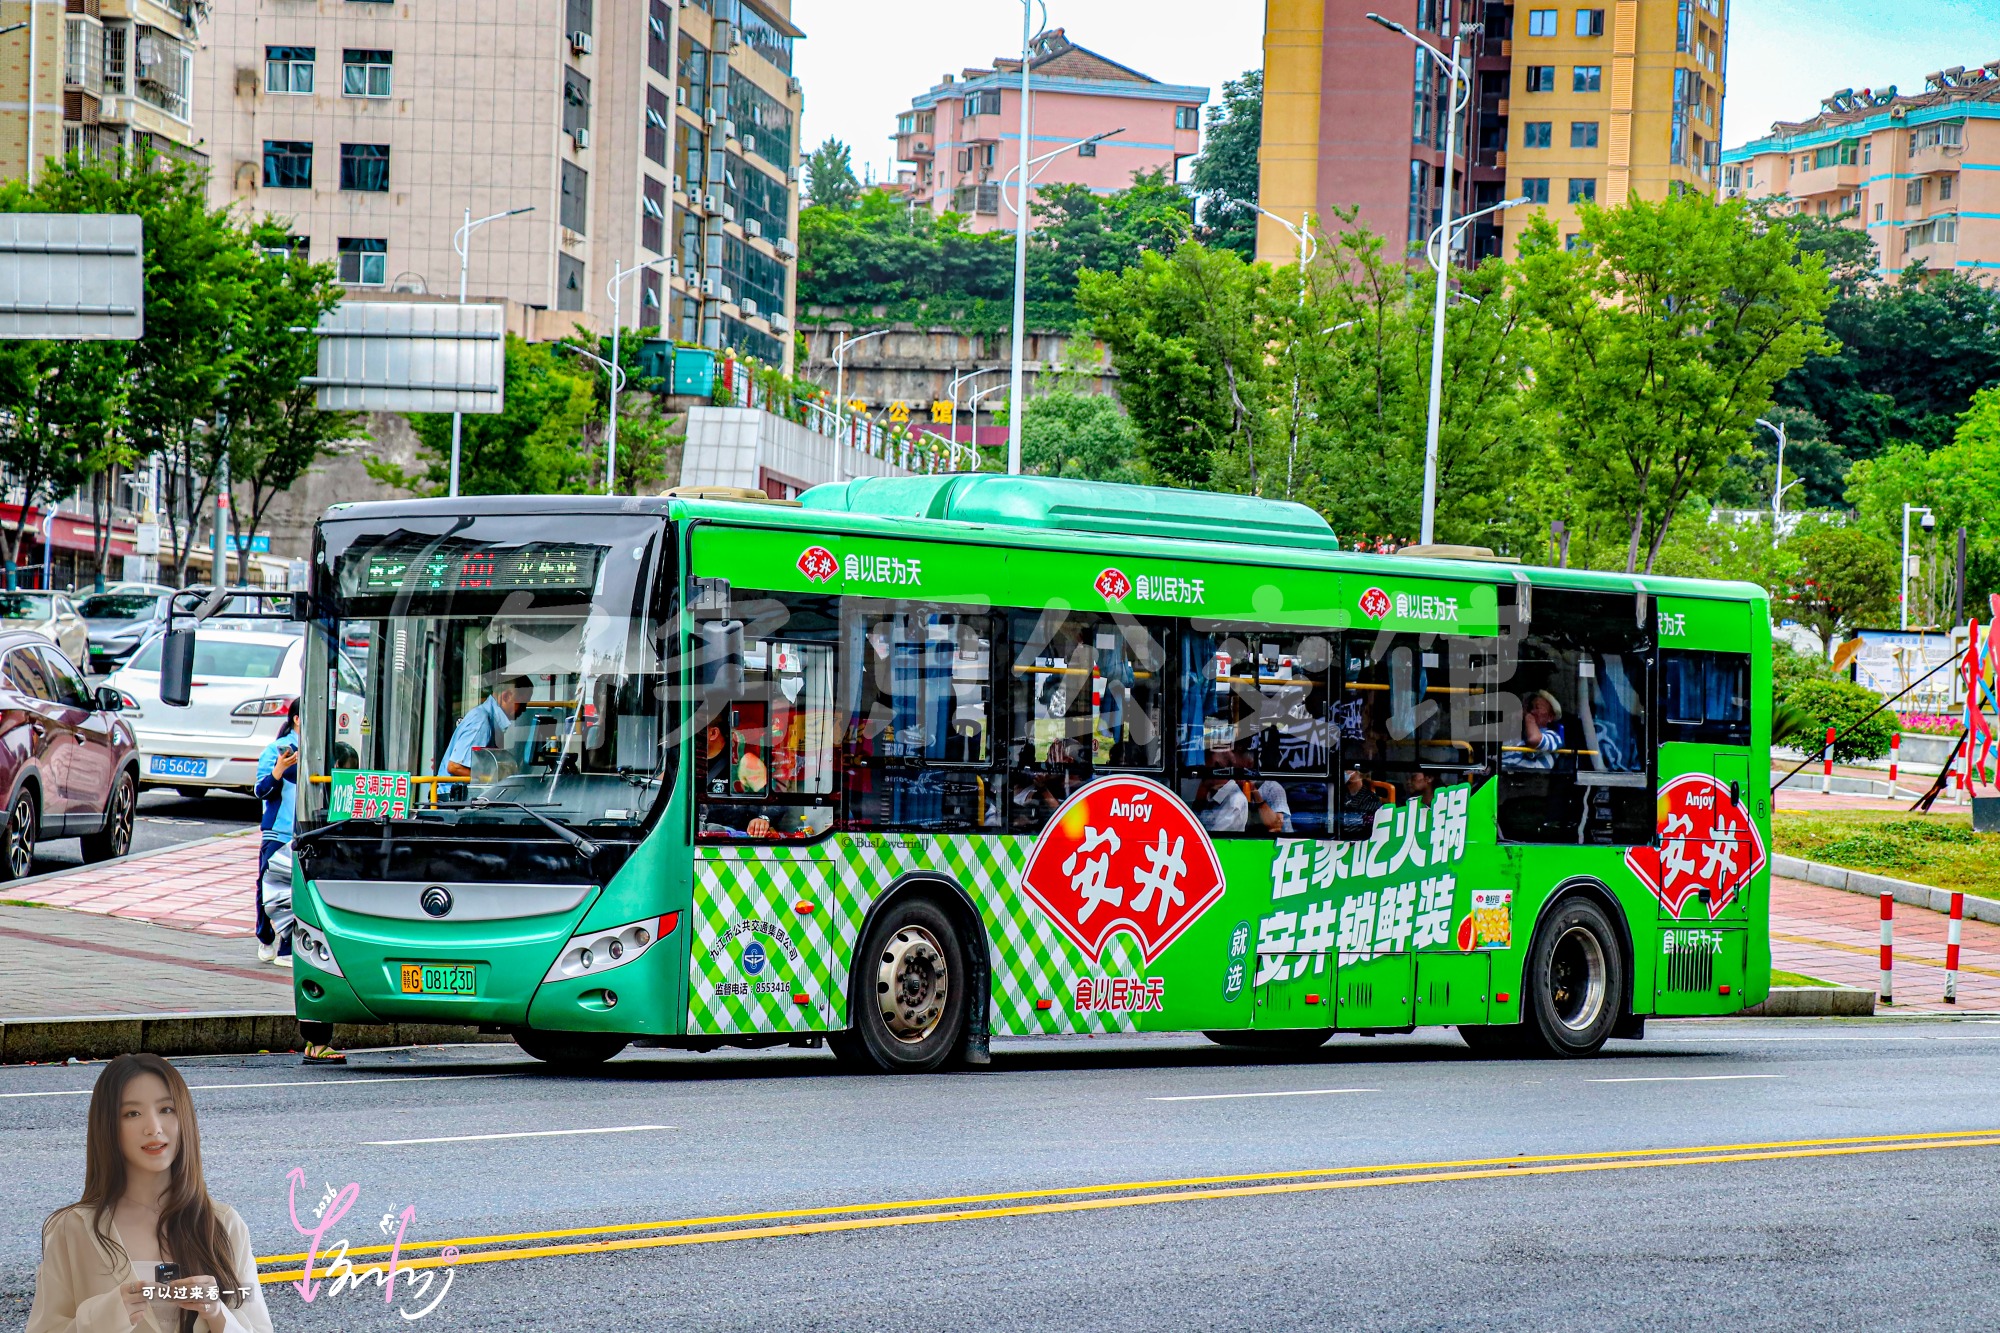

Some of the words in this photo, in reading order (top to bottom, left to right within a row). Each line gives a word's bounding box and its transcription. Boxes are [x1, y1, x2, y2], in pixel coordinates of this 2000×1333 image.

[844, 554, 922, 586] 食以民为天
[1136, 575, 1205, 605] 食以民为天
[1396, 594, 1458, 622] 食以民为天
[355, 774, 408, 798] 空调开启
[1685, 786, 1715, 810] Anjoy
[351, 798, 405, 820] 票价2元
[1110, 791, 1152, 822] Anjoy
[1271, 788, 1469, 900] 在家吃火锅
[1660, 813, 1739, 890] 安井
[1062, 825, 1187, 926] 安井
[710, 919, 798, 961] 九江市公共交通集团公司
[1253, 874, 1456, 988] 安井锁鲜装
[1663, 929, 1723, 955] 食以民为天
[1225, 928, 1249, 995] 就选
[1075, 976, 1164, 1013] 食以民为天
